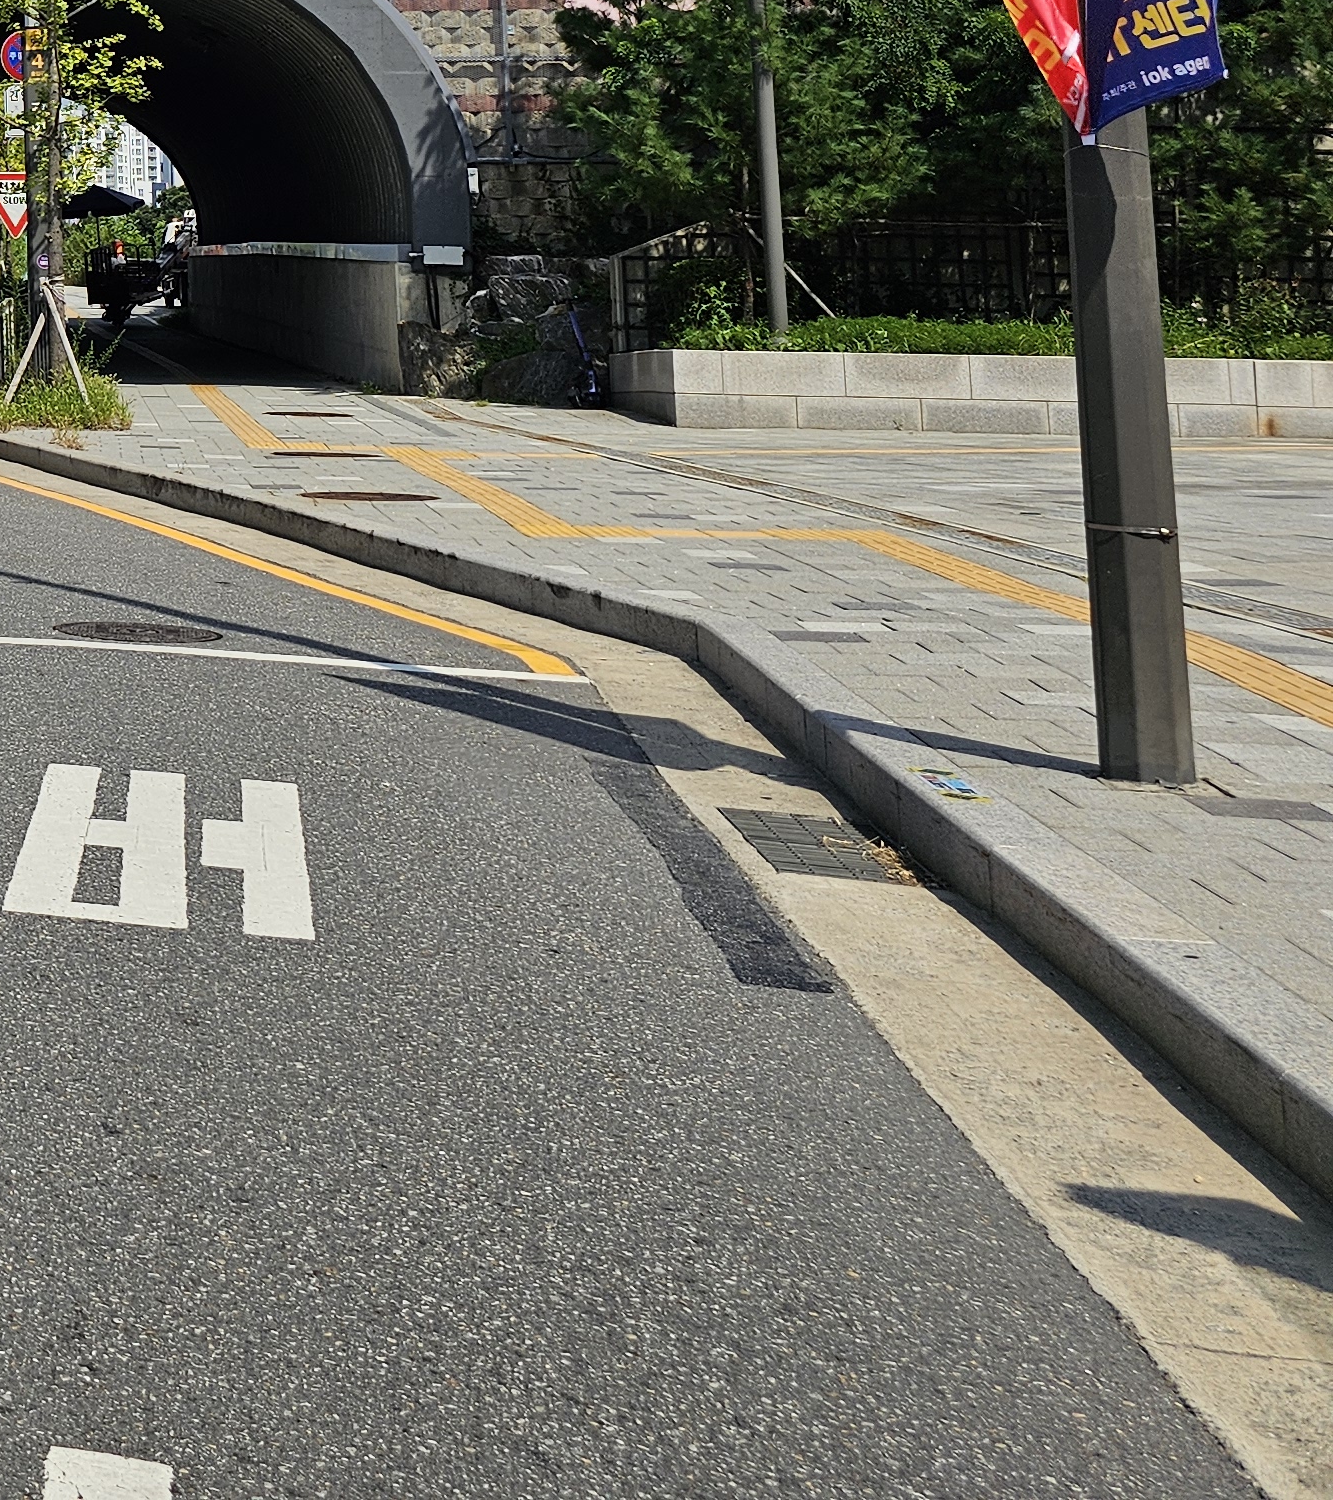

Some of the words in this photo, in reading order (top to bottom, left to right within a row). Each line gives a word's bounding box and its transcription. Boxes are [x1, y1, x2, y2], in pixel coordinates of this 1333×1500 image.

[31, 52, 45, 69] 4
[1140, 65, 1172, 86] iok
[1173, 56, 1210, 76] agen
[2, 763, 316, 940] 버
